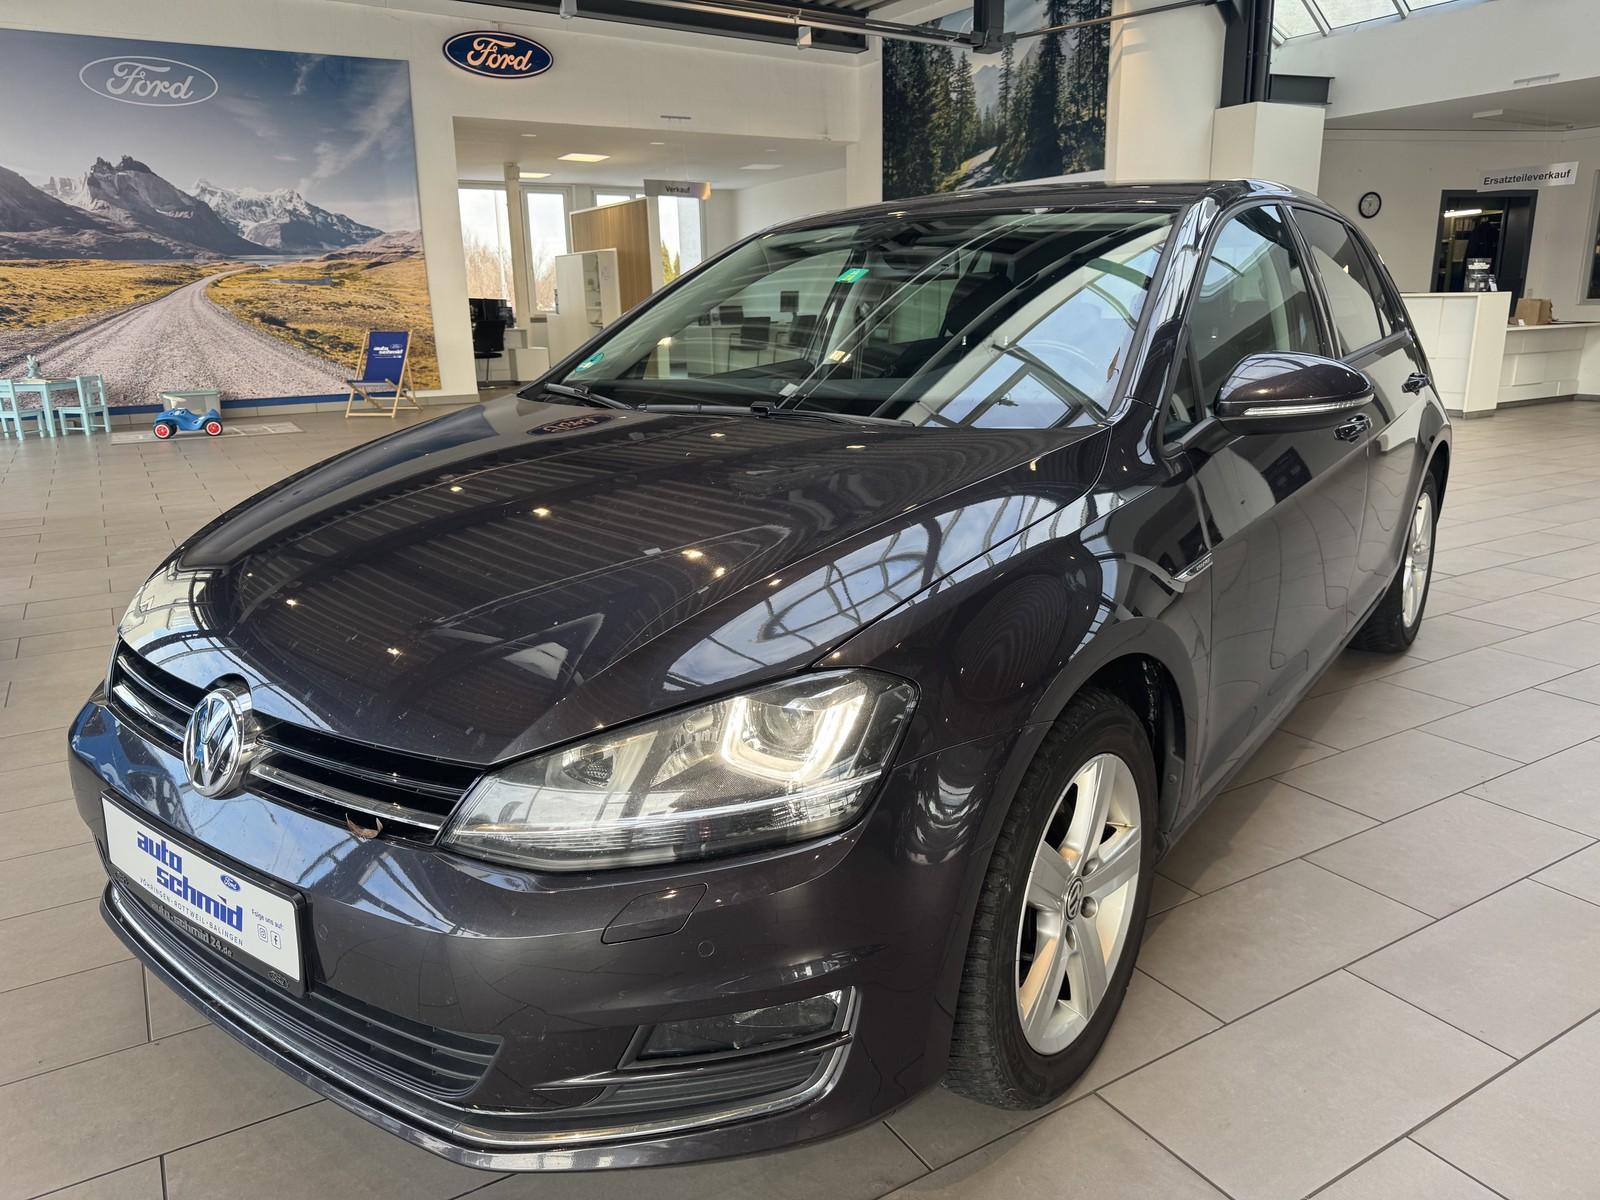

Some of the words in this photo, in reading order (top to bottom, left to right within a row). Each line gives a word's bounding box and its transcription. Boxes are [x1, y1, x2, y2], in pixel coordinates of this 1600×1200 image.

[467, 37, 533, 71] Ford
[106, 61, 194, 99] Ford
[664, 184, 691, 194] Verkauf
[1483, 168, 1572, 186] Ersatzteileverkauf
[137, 831, 182, 874] auto
[156, 866, 243, 932] schmid
